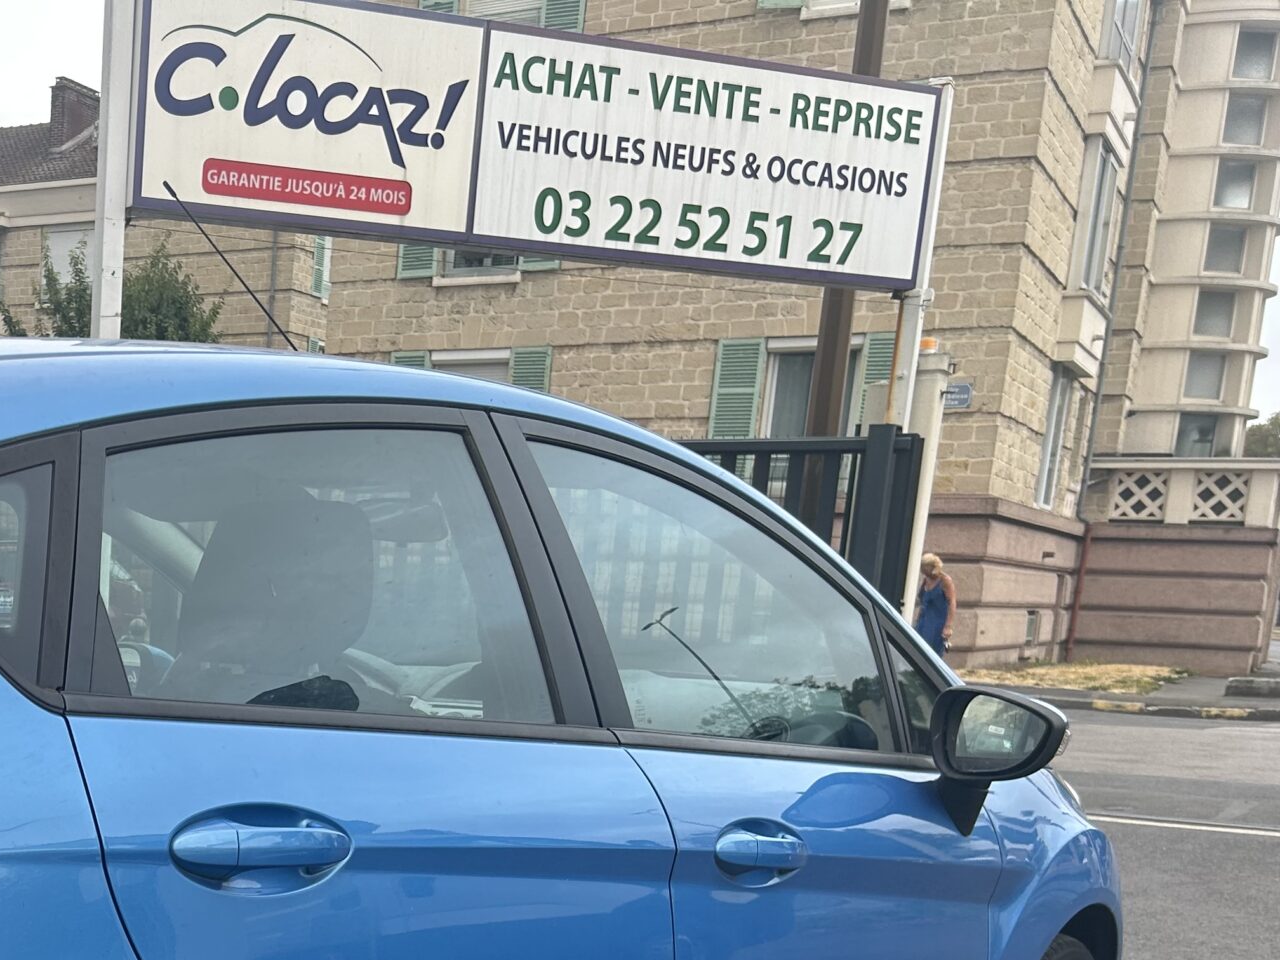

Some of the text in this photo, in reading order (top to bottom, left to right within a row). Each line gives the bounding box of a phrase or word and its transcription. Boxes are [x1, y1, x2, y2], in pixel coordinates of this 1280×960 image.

[493, 52, 620, 103] ACHAT
[649, 72, 762, 123] VENTE
[789, 93, 923, 145] REPRISE
[207, 169, 406, 206] GARANTIE JUSQU'À 24 MOIS
[497, 121, 908, 198] VEHICULES NEUFS & OCCASIONS
[534, 187, 863, 266] 03 22 52 51 27
